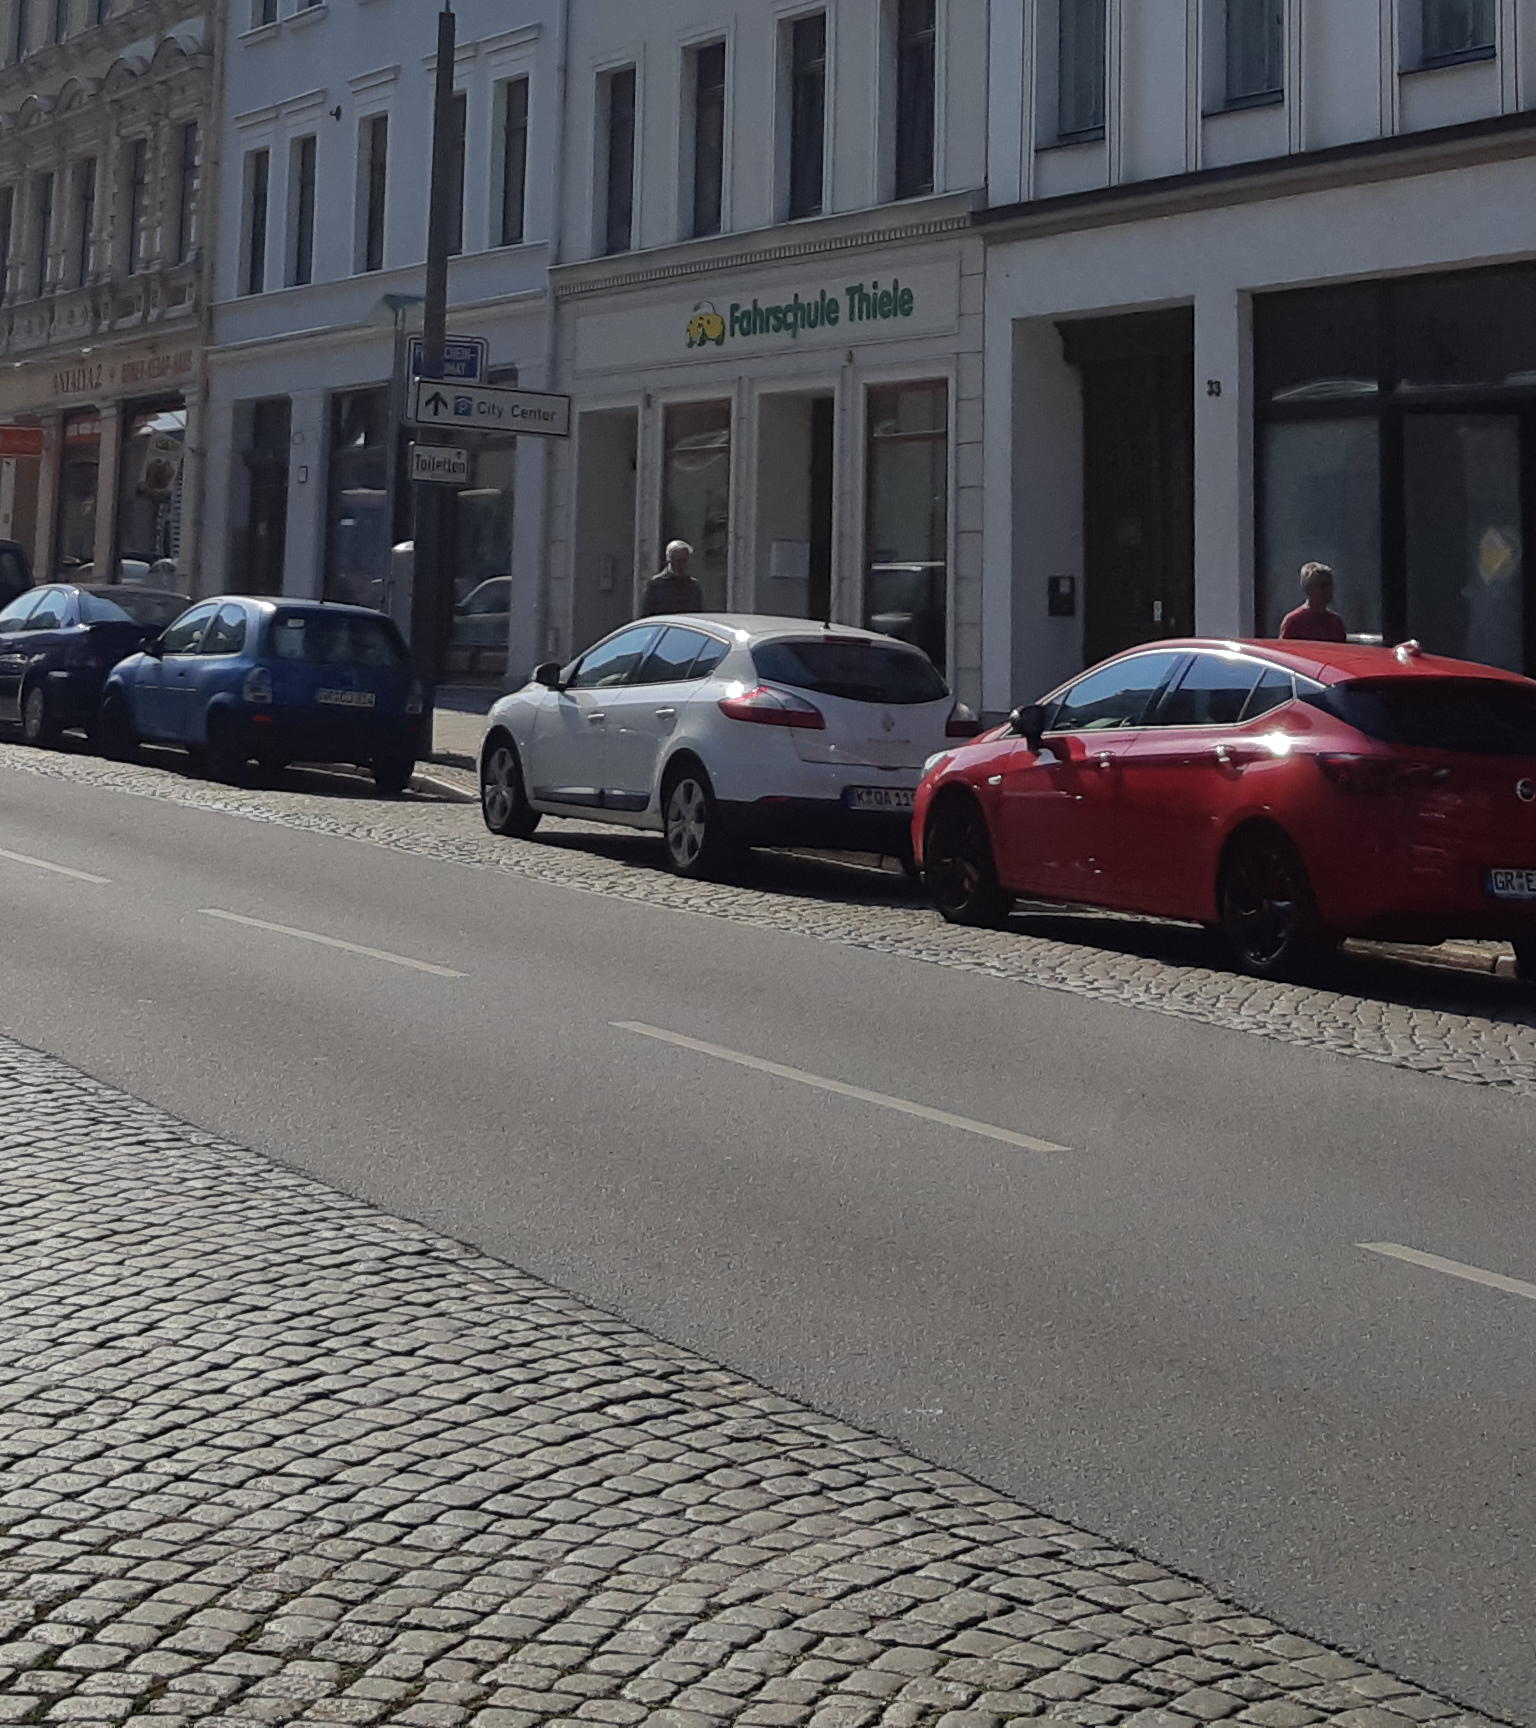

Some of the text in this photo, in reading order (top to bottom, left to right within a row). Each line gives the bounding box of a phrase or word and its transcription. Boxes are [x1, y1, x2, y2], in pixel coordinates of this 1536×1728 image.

[729, 278, 914, 338] Fahrschule Thiele
[477, 401, 505, 419] City
[511, 405, 557, 421] Center
[416, 453, 466, 473] Toiletten
